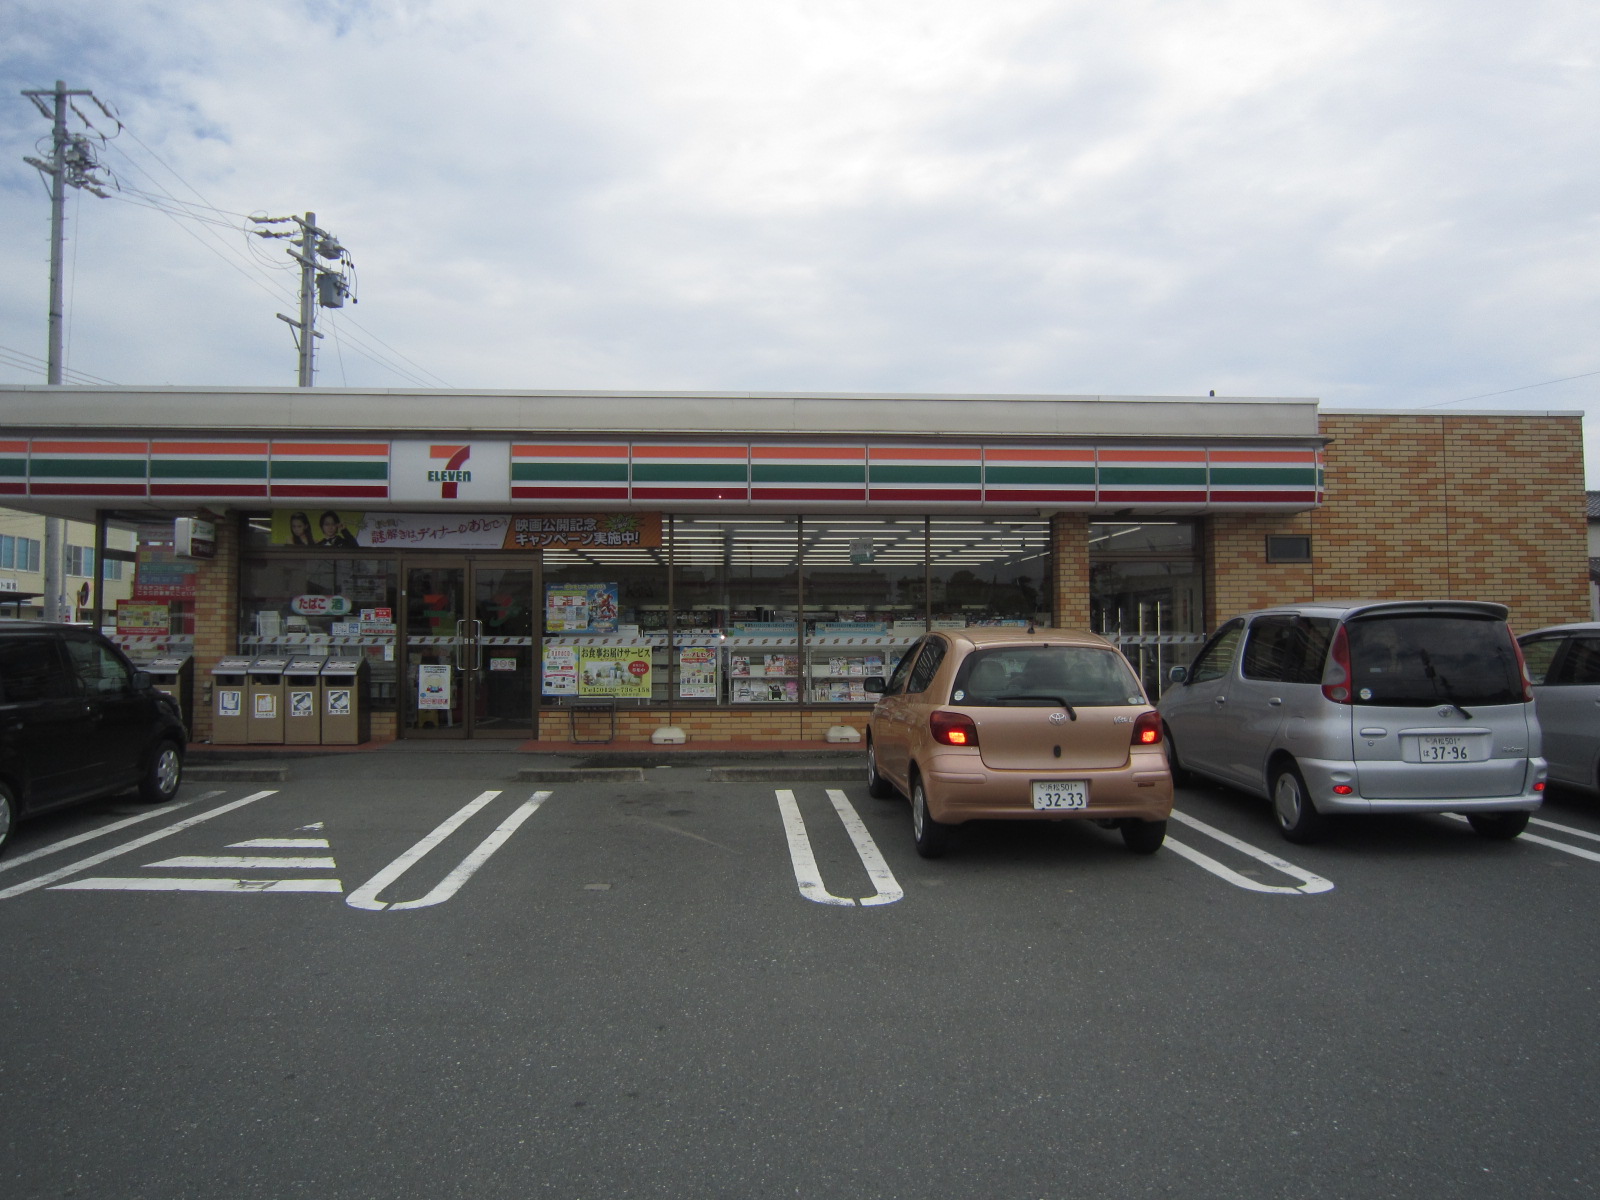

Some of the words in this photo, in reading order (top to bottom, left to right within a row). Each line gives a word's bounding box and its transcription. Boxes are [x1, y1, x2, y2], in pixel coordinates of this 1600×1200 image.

[430, 445, 470, 498] 7
[371, 518, 508, 544] 謎解きはディナーのあとで
[515, 518, 598, 532] 映画公開記念
[515, 532, 639, 546] キャンペーン実施中!
[298, 598, 327, 610] たばこ
[331, 598, 344, 610] 酒
[581, 647, 651, 659] お食事お届けサービス
[1431, 746, 1467, 760] 37-96
[1045, 792, 1083, 807] 32-33
